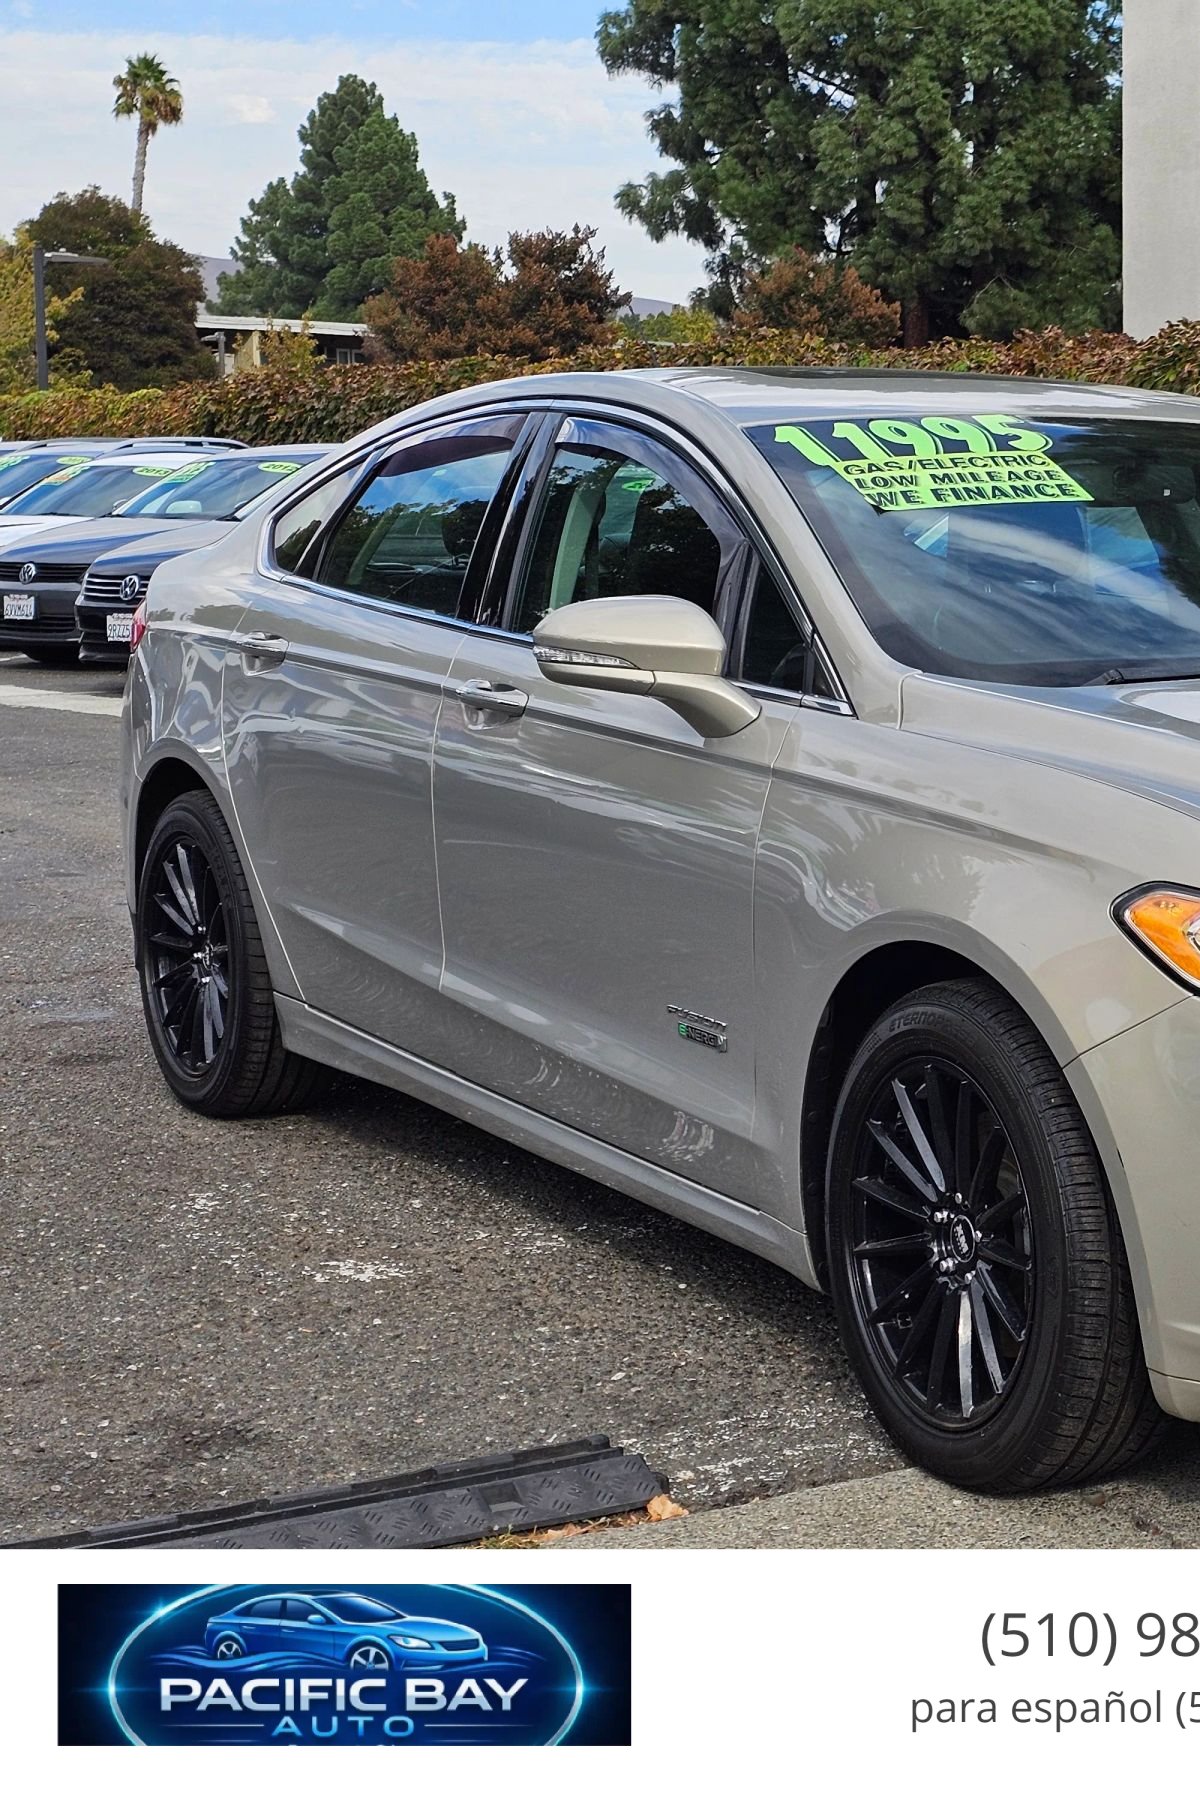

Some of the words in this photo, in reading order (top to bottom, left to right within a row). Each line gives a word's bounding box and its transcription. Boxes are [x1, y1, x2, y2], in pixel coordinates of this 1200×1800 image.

[774, 414, 1054, 466] 11995
[843, 454, 1050, 475] GAS/ELECTRIC
[854, 474, 919, 490] LOW
[931, 469, 1065, 486] MILEAGE
[866, 489, 924, 508] WE
[934, 483, 1077, 502] FINANCE
